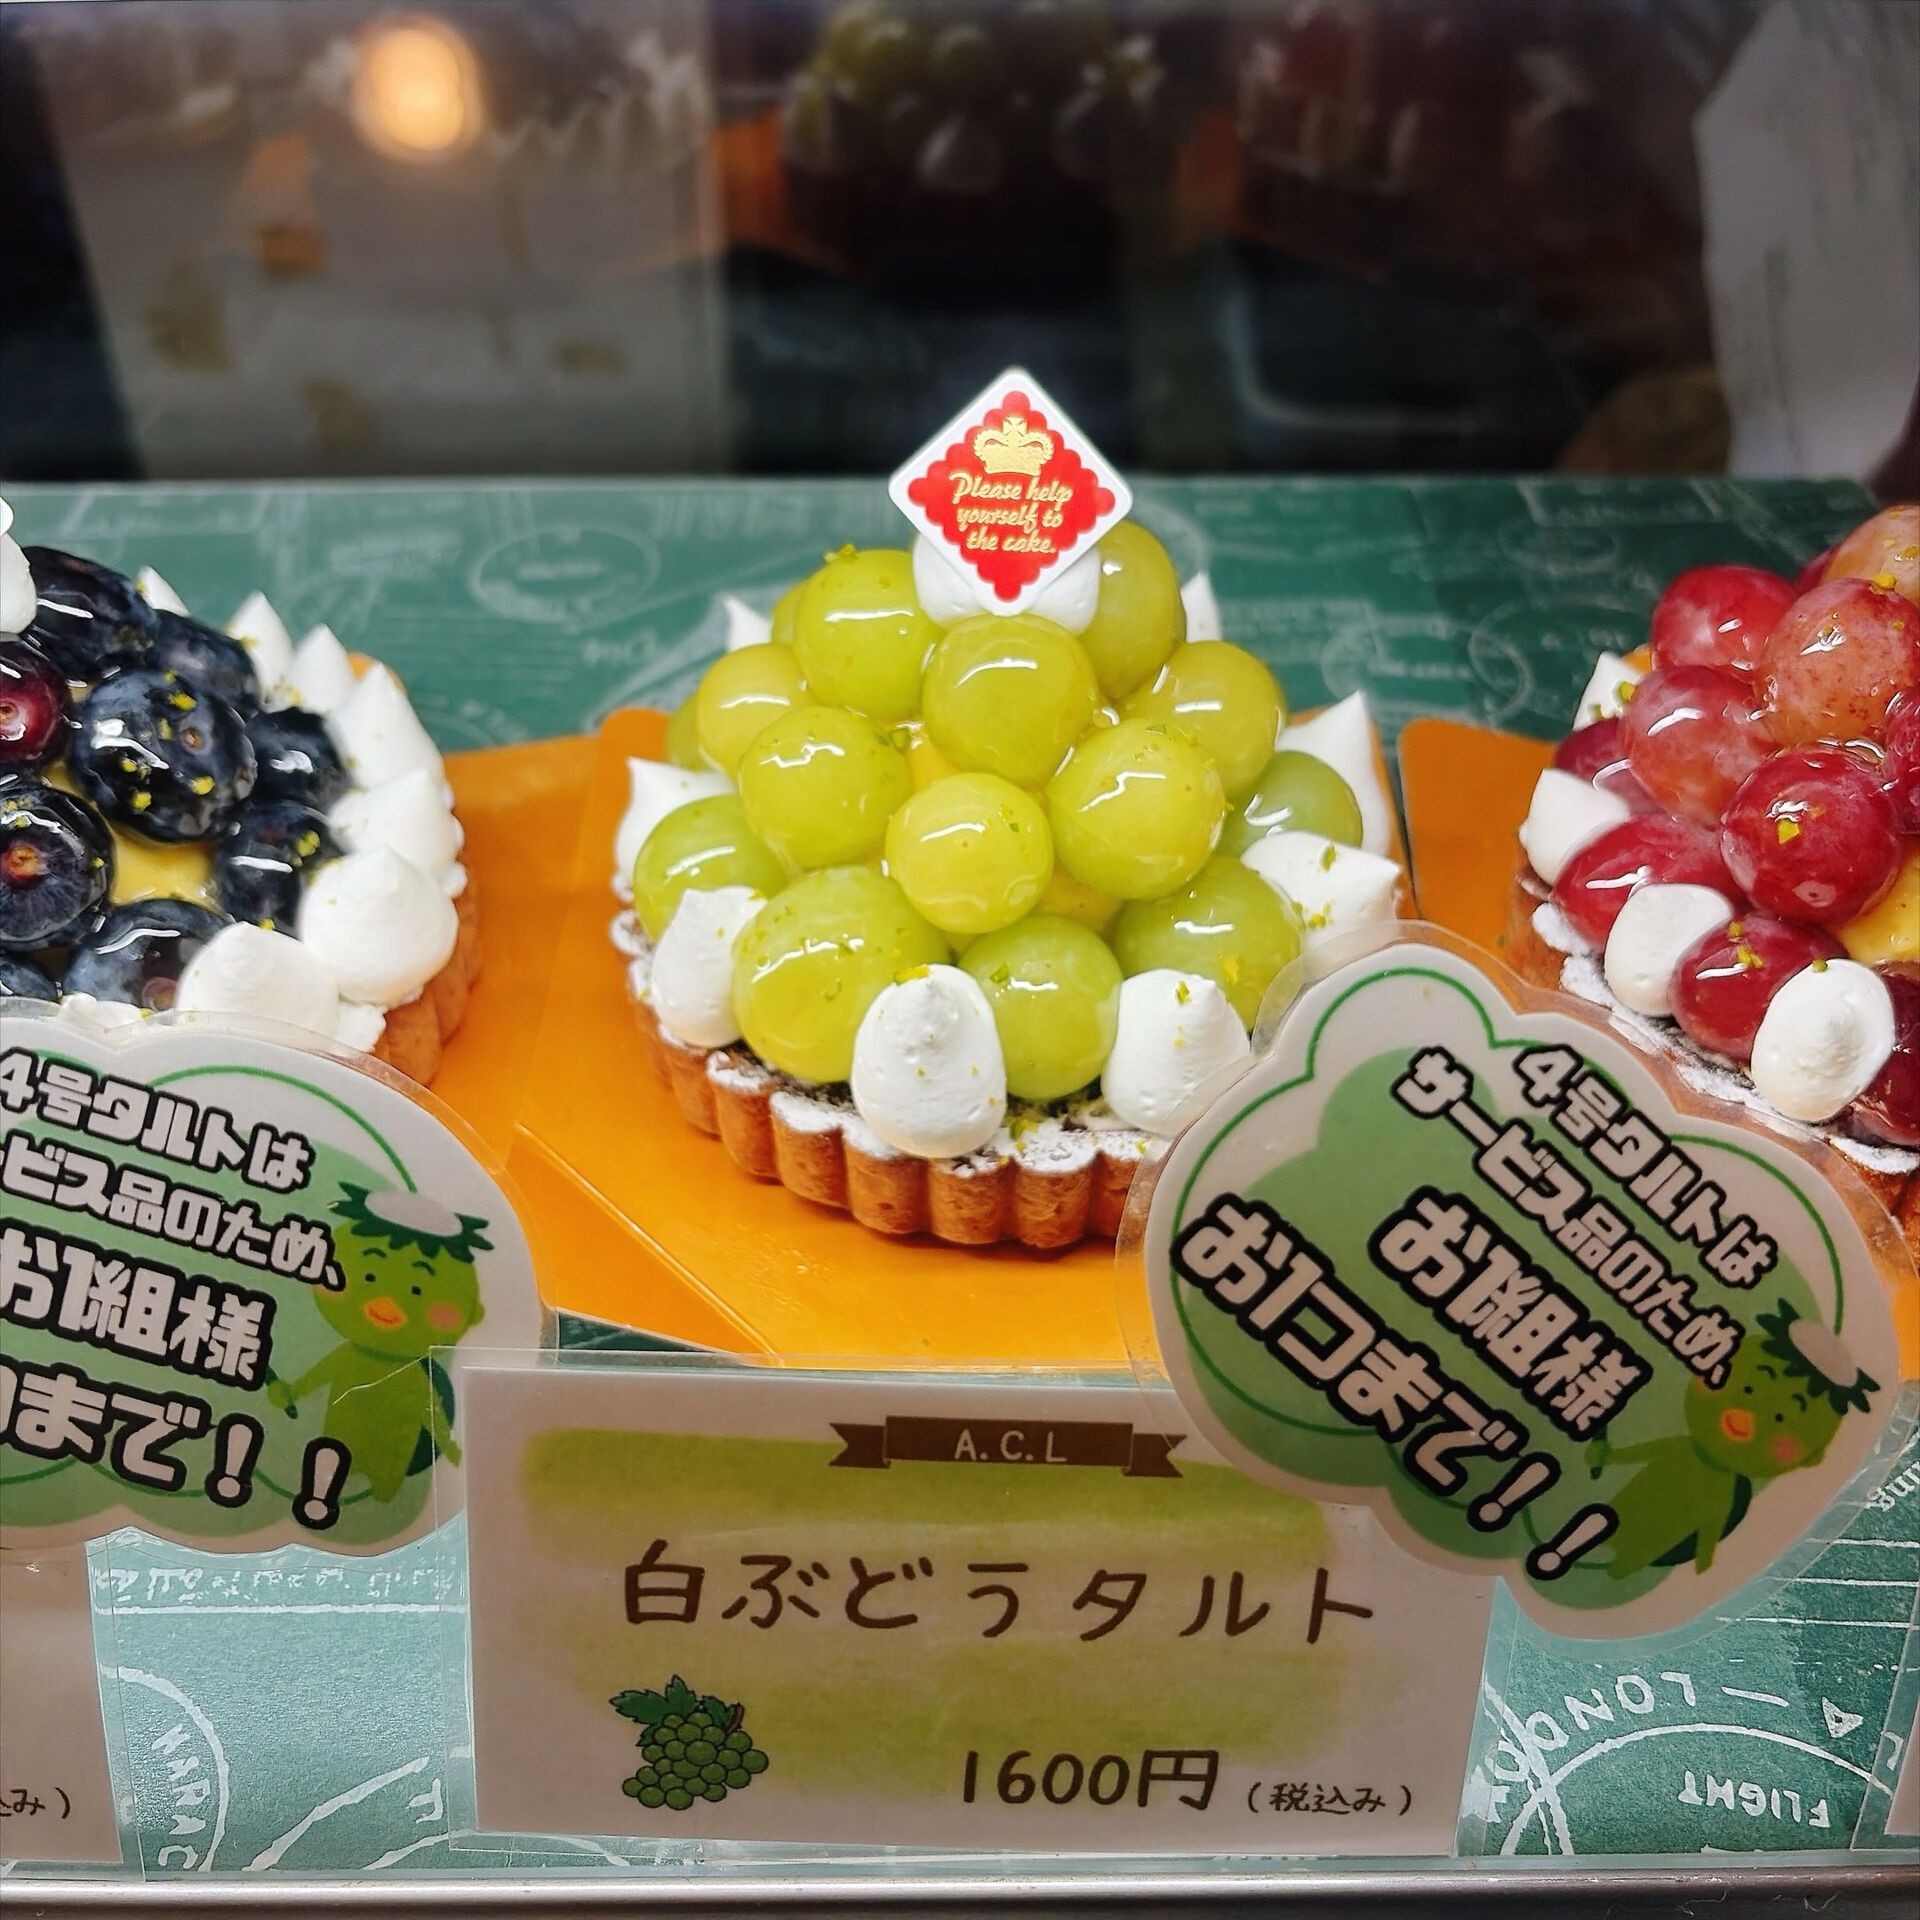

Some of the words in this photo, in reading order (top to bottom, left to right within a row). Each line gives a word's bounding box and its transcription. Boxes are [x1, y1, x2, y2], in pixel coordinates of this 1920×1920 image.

[949, 471, 1022, 504] Please
[1025, 475, 1074, 511] help
[956, 503, 1039, 534] yourself
[1042, 508, 1064, 528] to
[966, 526, 998, 551] the
[1001, 529, 1057, 554] cake.
[0, 1046, 315, 1193] 4号タルトは
[1511, 1042, 1779, 1290] 4号タルトは
[0, 1129, 347, 1292] ビス品のため、
[1391, 1045, 1745, 1390] サービス品のため、
[1369, 1186, 1653, 1440] お1組様
[954, 1428, 1068, 1463] A.C.L
[624, 1538, 1374, 1644] 白ぶどうタルト
[962, 1749, 1219, 1811] 1600円
[1678, 1769, 1831, 1829] FLIGHT
